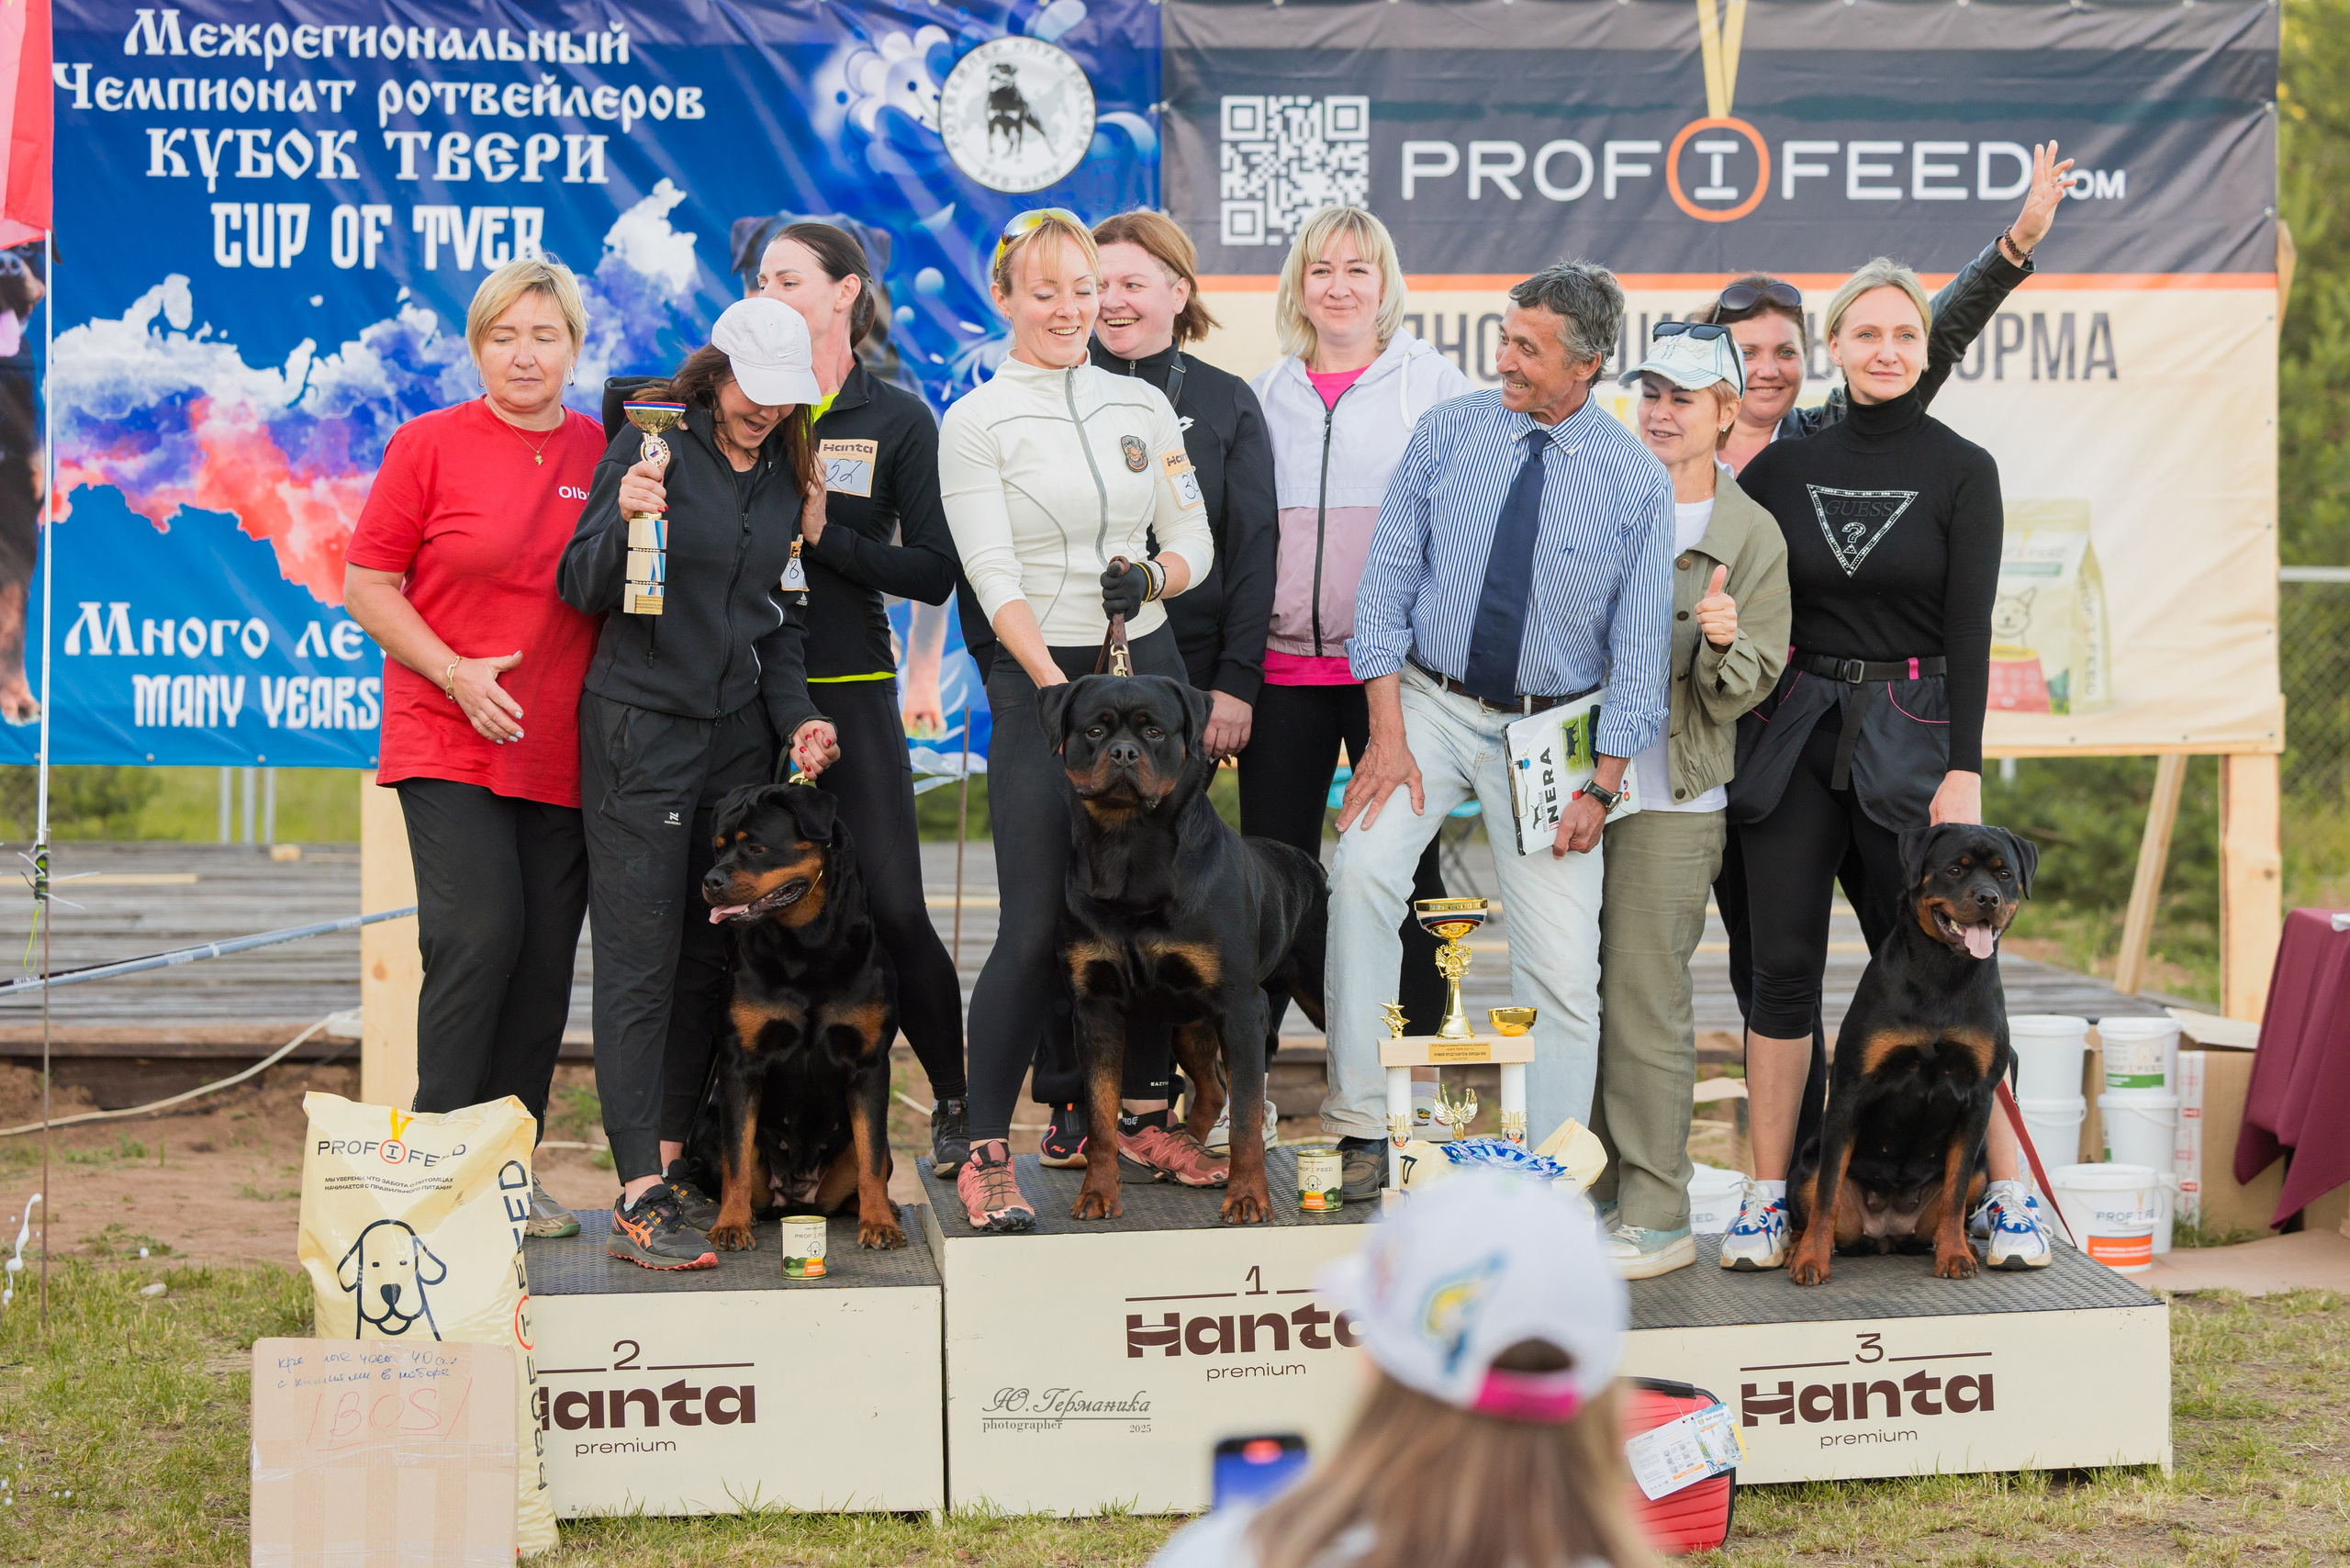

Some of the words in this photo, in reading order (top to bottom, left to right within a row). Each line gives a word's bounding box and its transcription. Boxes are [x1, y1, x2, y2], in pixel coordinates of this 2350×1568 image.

[125, 9, 630, 72] Межрегиональный
[54, 62, 356, 112] Чемпионат
[378, 73, 706, 134] ротвейлеров
[146, 128, 360, 193] КУБОК
[384, 130, 610, 184] ТВЕРИ
[212, 203, 310, 268] CUP
[331, 204, 392, 269] OF
[412, 205, 545, 272] TVER
[822, 442, 873, 454] Hanta
[558, 486, 590, 500] Olb
[1824, 499, 1895, 517] GUESS
[64, 602, 270, 658] Много
[295, 620, 386, 661] ле
[132, 675, 245, 727] MANY
[261, 676, 380, 731] YEARS
[1539, 746, 1560, 824] NERA
[318, 1139, 466, 1168] PROFIFED
[382, 1179, 409, 1188] ЗАБОТА
[1245, 1265, 1269, 1295] 1
[613, 1339, 641, 1371] 2
[1855, 1332, 1884, 1363] 3
[1205, 1361, 1306, 1383] premium
[1740, 1368, 1995, 1428] Hanta
[575, 1437, 677, 1458] premium
[1819, 1428, 1919, 1450] premium
